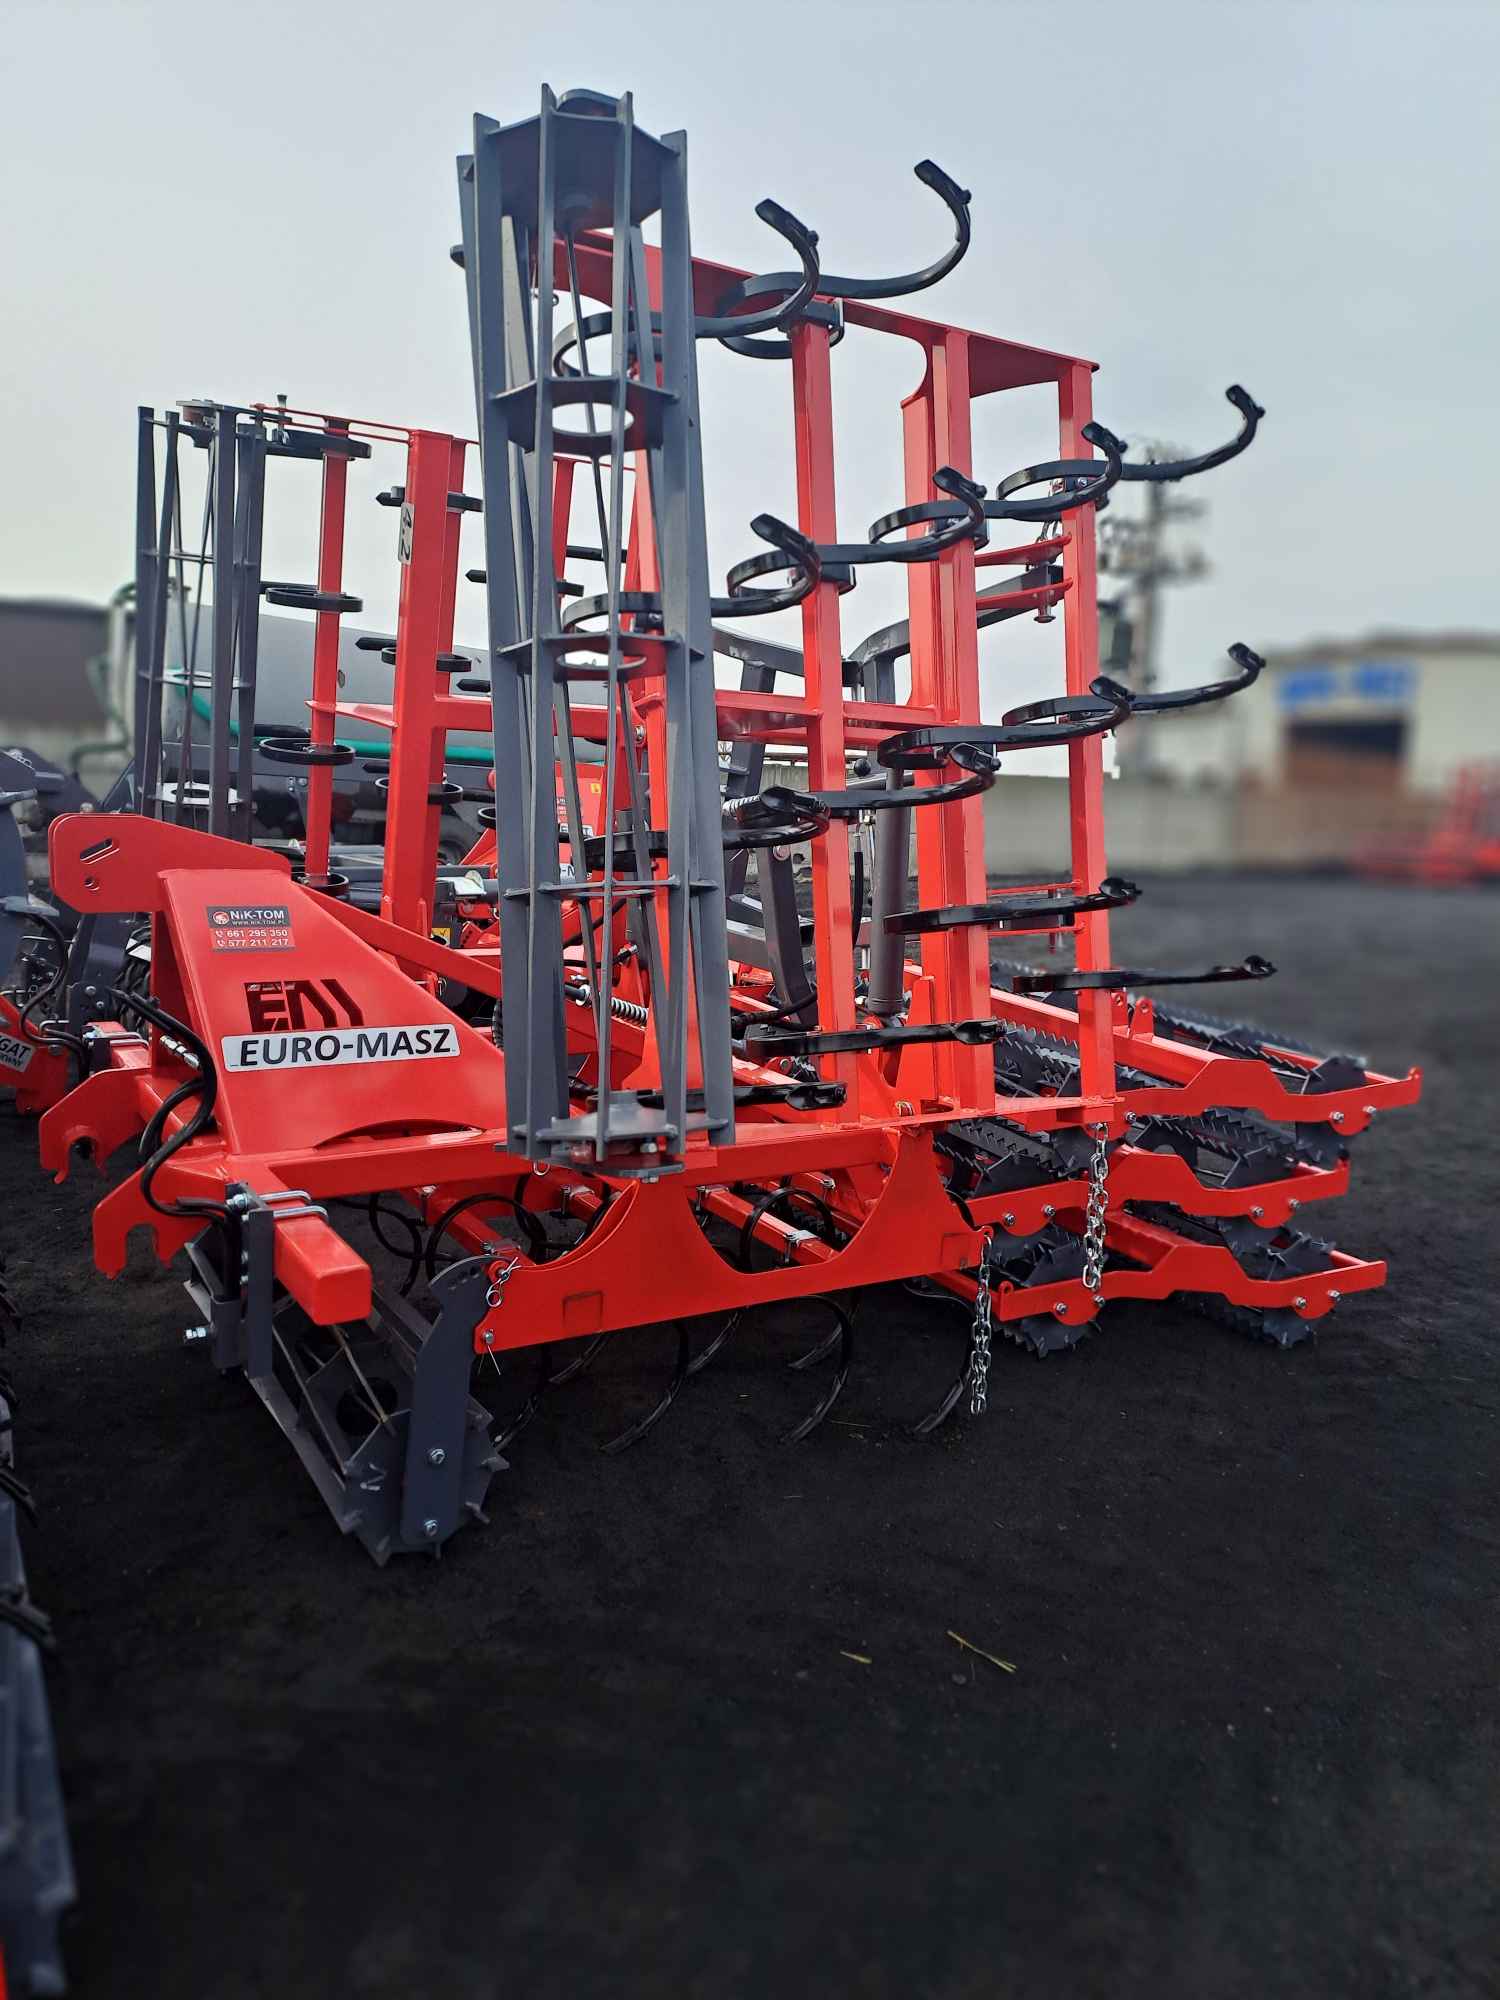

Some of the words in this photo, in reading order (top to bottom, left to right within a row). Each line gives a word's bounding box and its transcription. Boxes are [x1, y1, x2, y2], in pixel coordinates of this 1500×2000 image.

[227, 930, 245, 938] 661
[248, 929, 267, 937] 295
[269, 929, 288, 937] 350
[240, 1029, 451, 1066] EURO-MASZ
